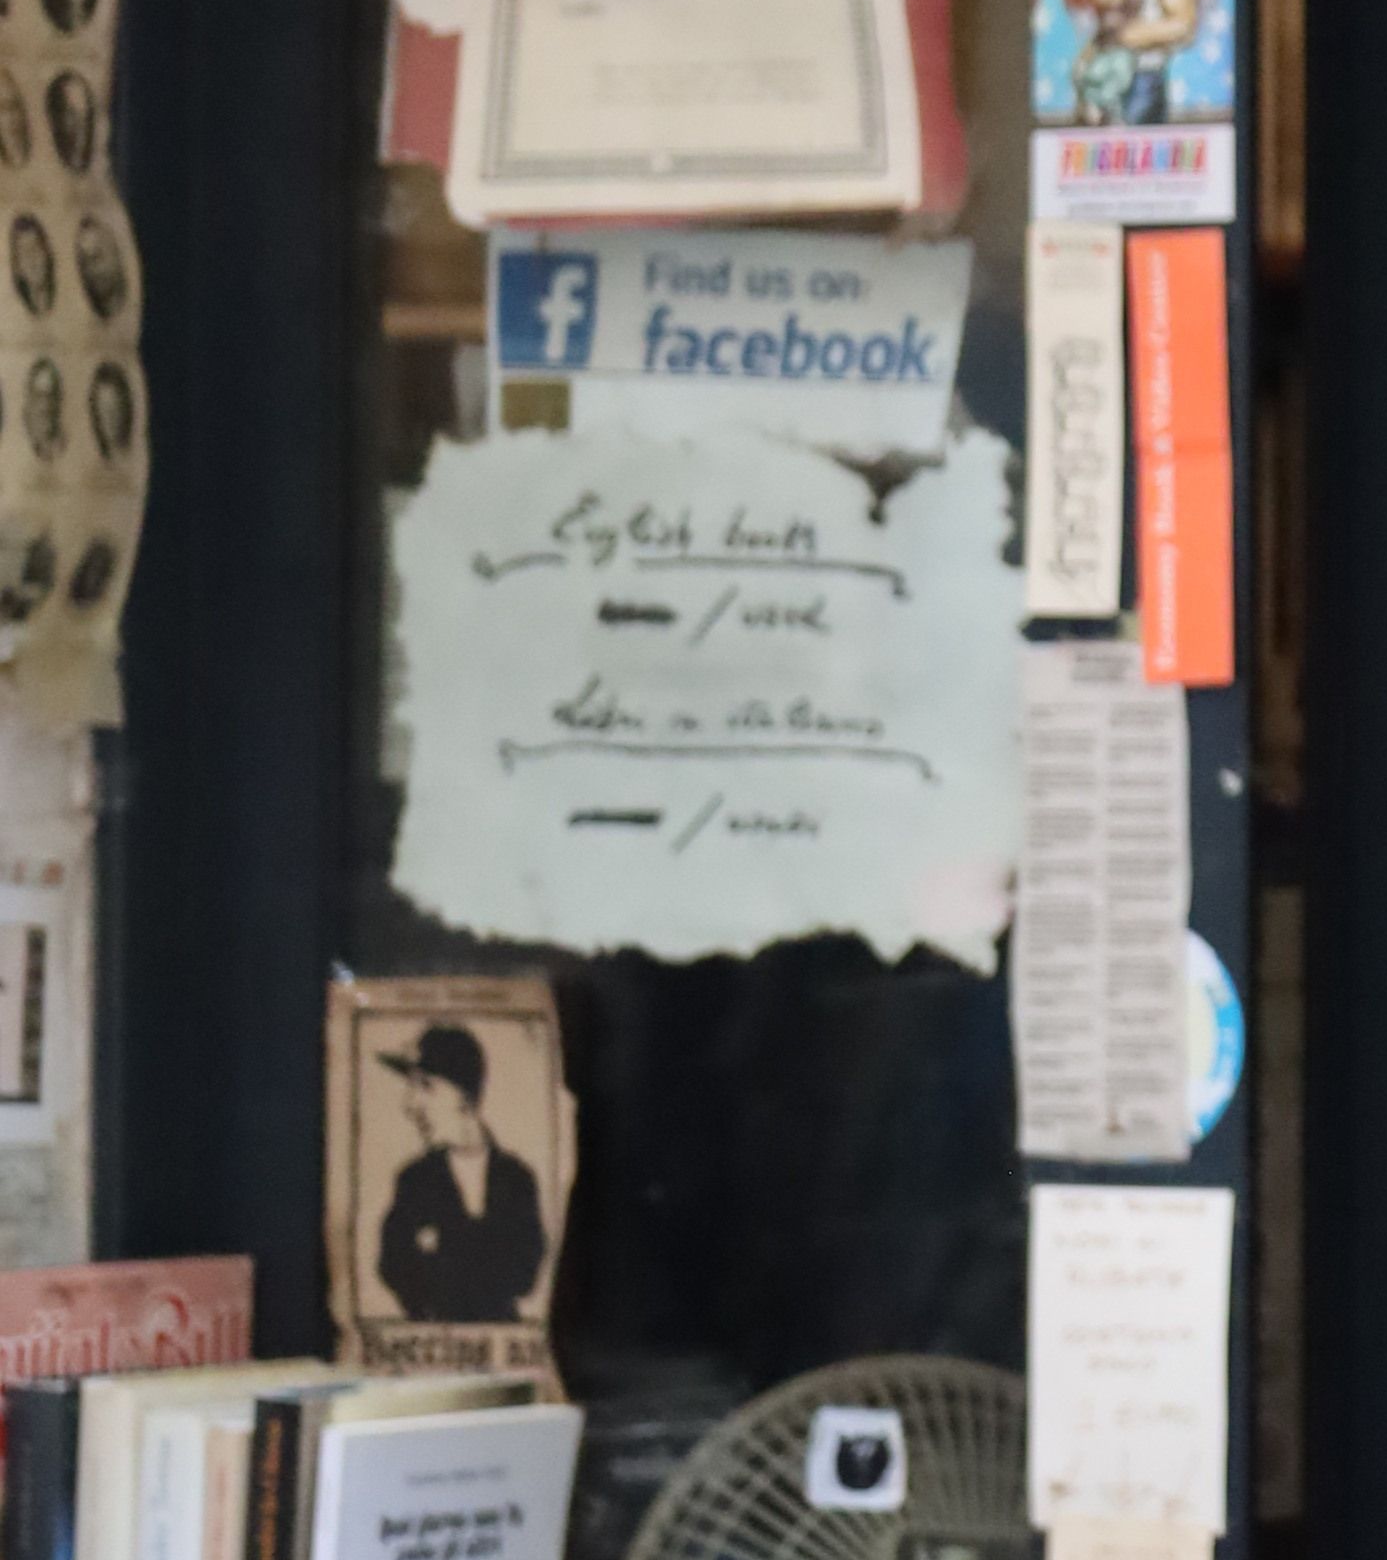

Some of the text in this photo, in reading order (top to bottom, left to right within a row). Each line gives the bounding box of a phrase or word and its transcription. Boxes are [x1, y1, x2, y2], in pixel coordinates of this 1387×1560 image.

[746, 260, 792, 302] us
[808, 262, 862, 304] on
[641, 305, 934, 381] facebook
